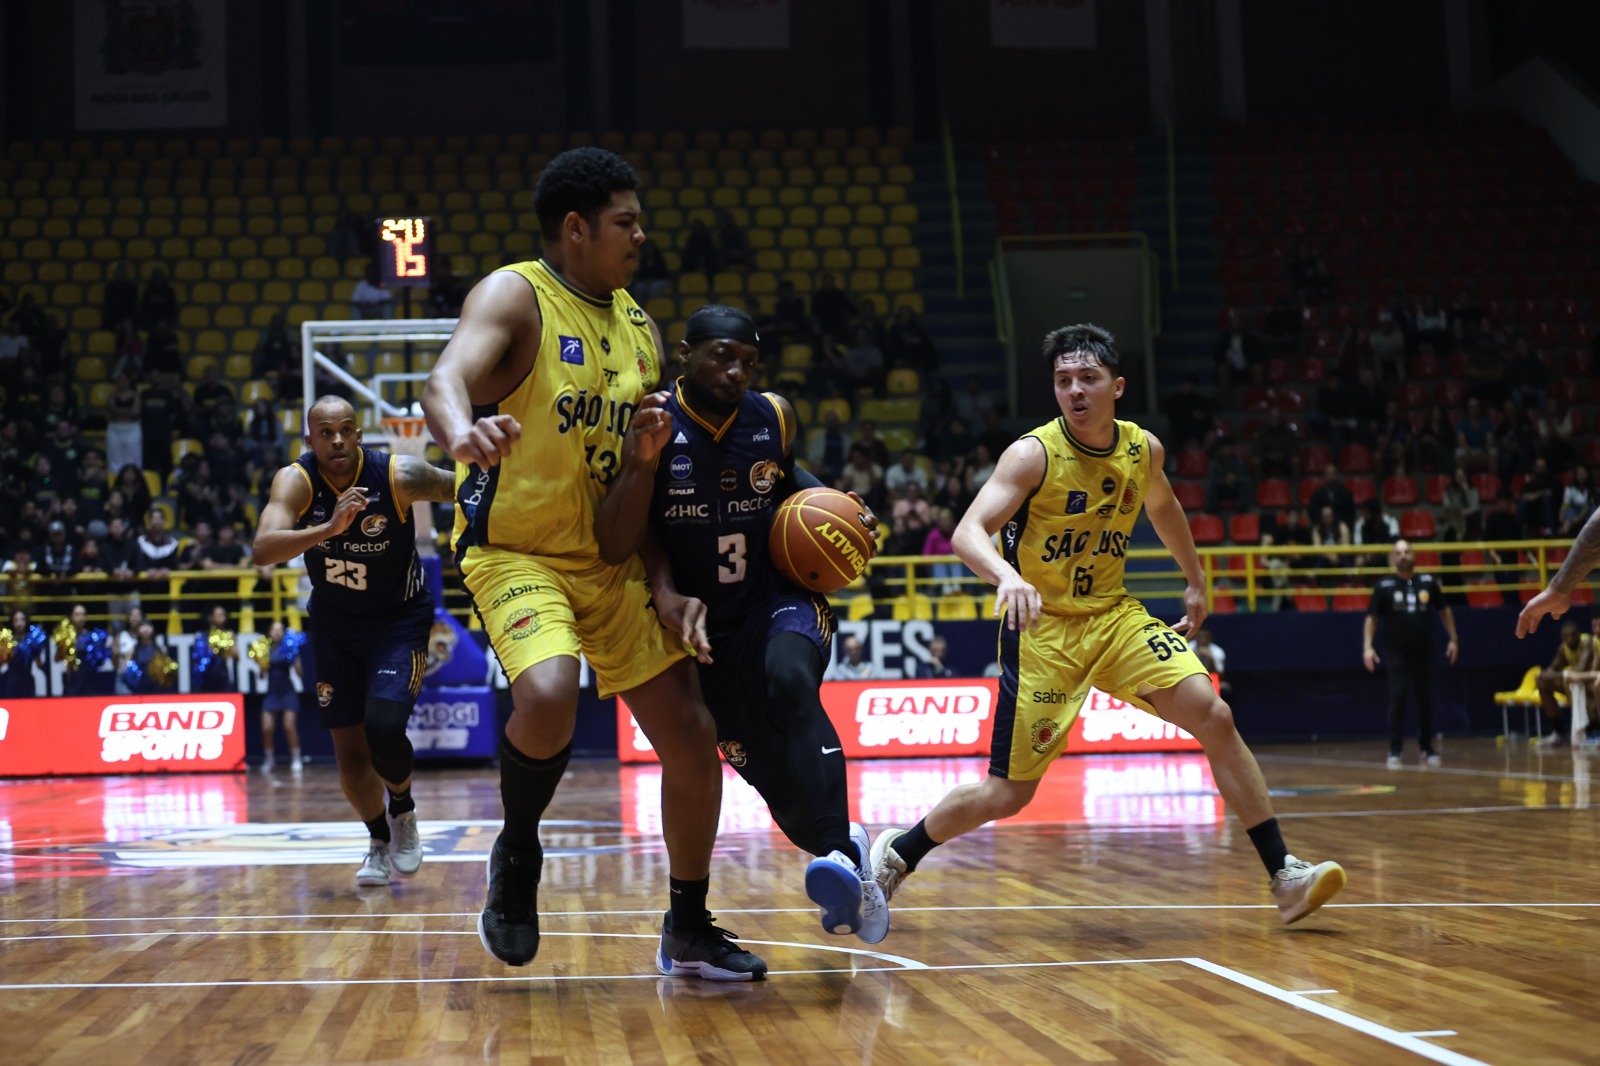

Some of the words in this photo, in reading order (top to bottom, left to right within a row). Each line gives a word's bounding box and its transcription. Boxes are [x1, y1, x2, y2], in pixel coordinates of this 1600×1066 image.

[557, 390, 603, 434] SÃO
[585, 445, 617, 485] 13
[718, 533, 747, 584] 3
[814, 522, 865, 575] PENALTY
[1041, 528, 1091, 563] SÃO
[324, 556, 368, 591] 23
[1147, 632, 1188, 661] 55
[868, 696, 980, 715] BAND
[1033, 688, 1067, 704] sabin
[110, 710, 225, 731] BAND
[858, 719, 980, 746] SPORTS
[100, 734, 224, 762] SPORTS
